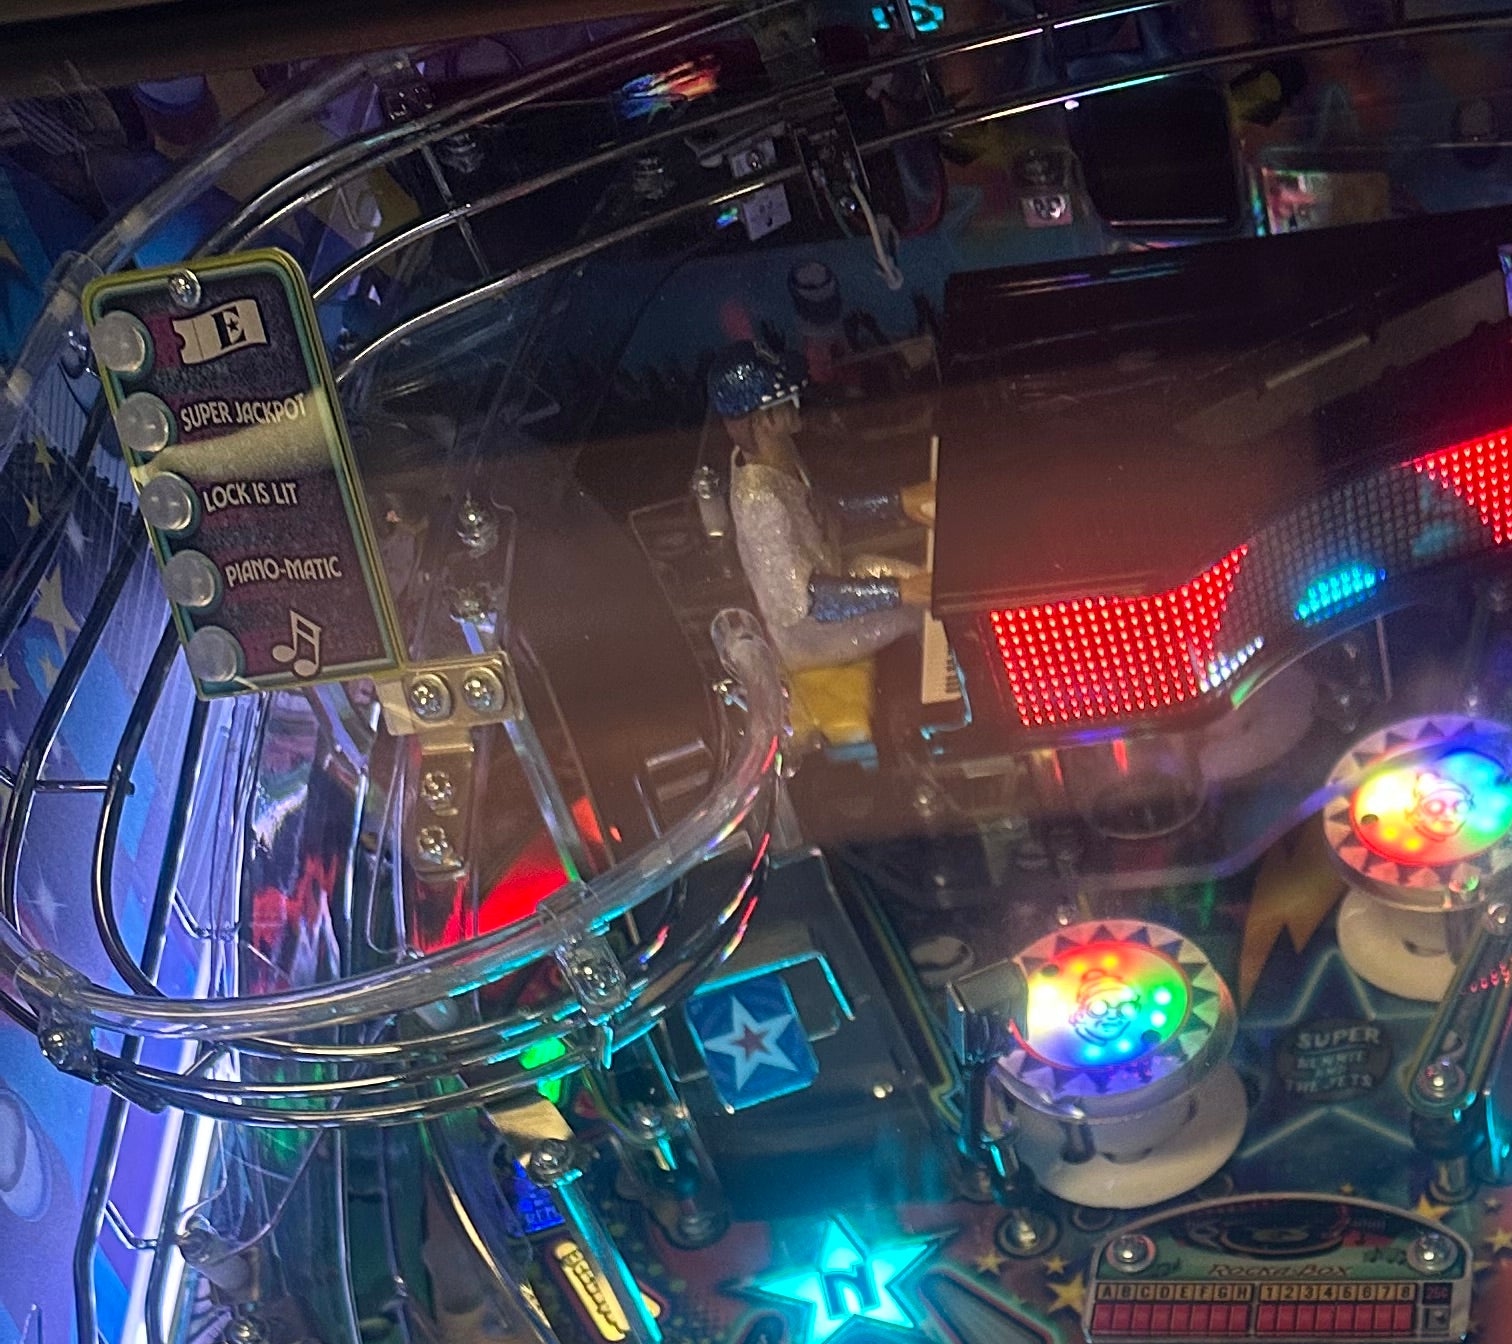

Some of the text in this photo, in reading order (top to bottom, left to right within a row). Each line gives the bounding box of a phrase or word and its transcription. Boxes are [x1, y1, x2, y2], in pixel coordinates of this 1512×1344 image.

[180, 394, 306, 431] SUPER JACKPOT
[203, 482, 299, 511] LOCK IS LIT
[225, 556, 342, 586] PIANO-MATIC
[1297, 1026, 1380, 1048] SUPER
